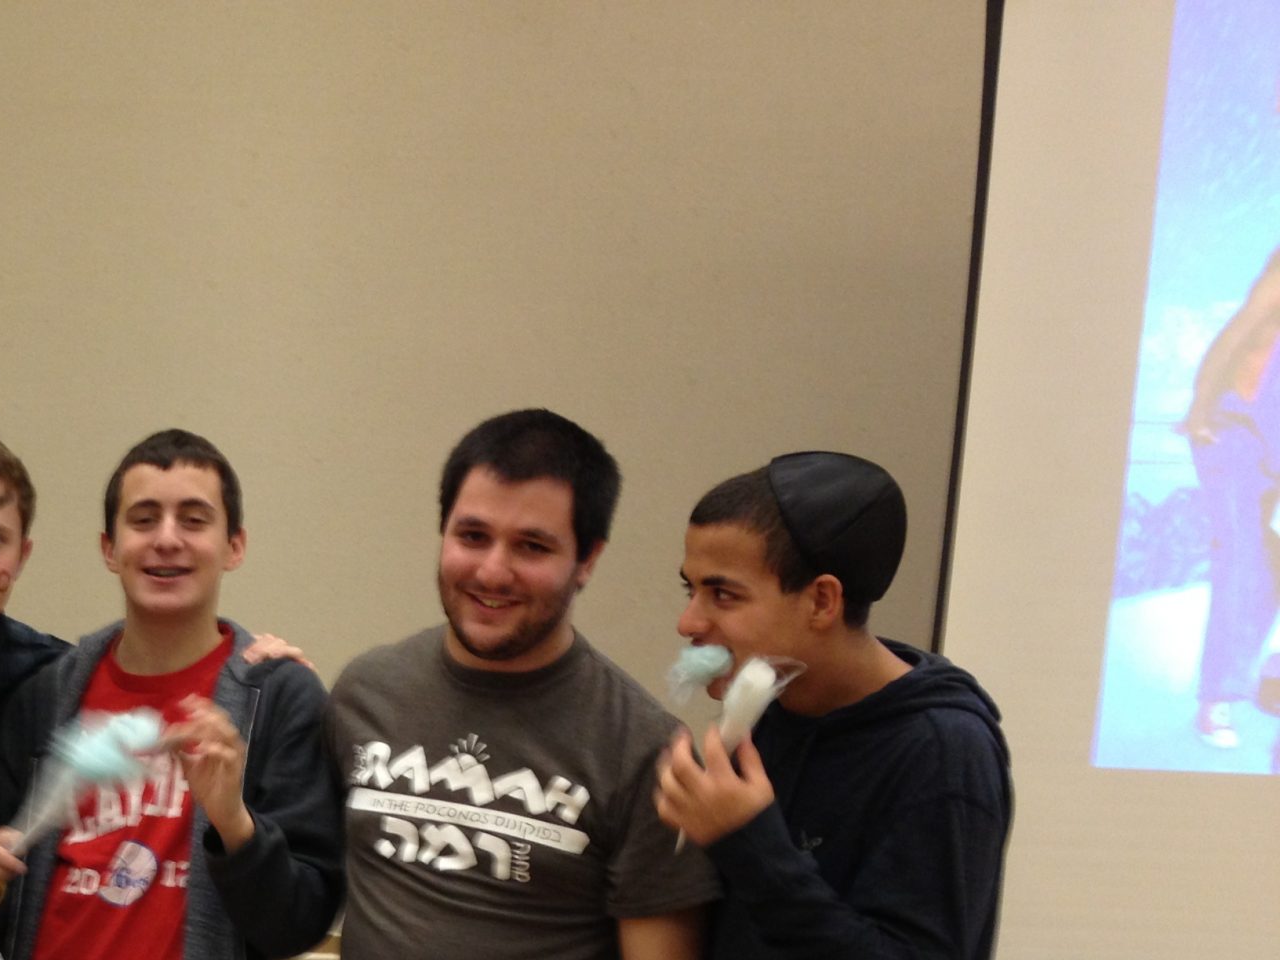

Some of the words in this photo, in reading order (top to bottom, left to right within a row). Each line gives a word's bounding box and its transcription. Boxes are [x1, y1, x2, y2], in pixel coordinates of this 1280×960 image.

[361, 741, 590, 825] RAMAH
[372, 797, 385, 809] IN
[387, 798, 410, 812] THE
[415, 801, 489, 825] POCONOS
